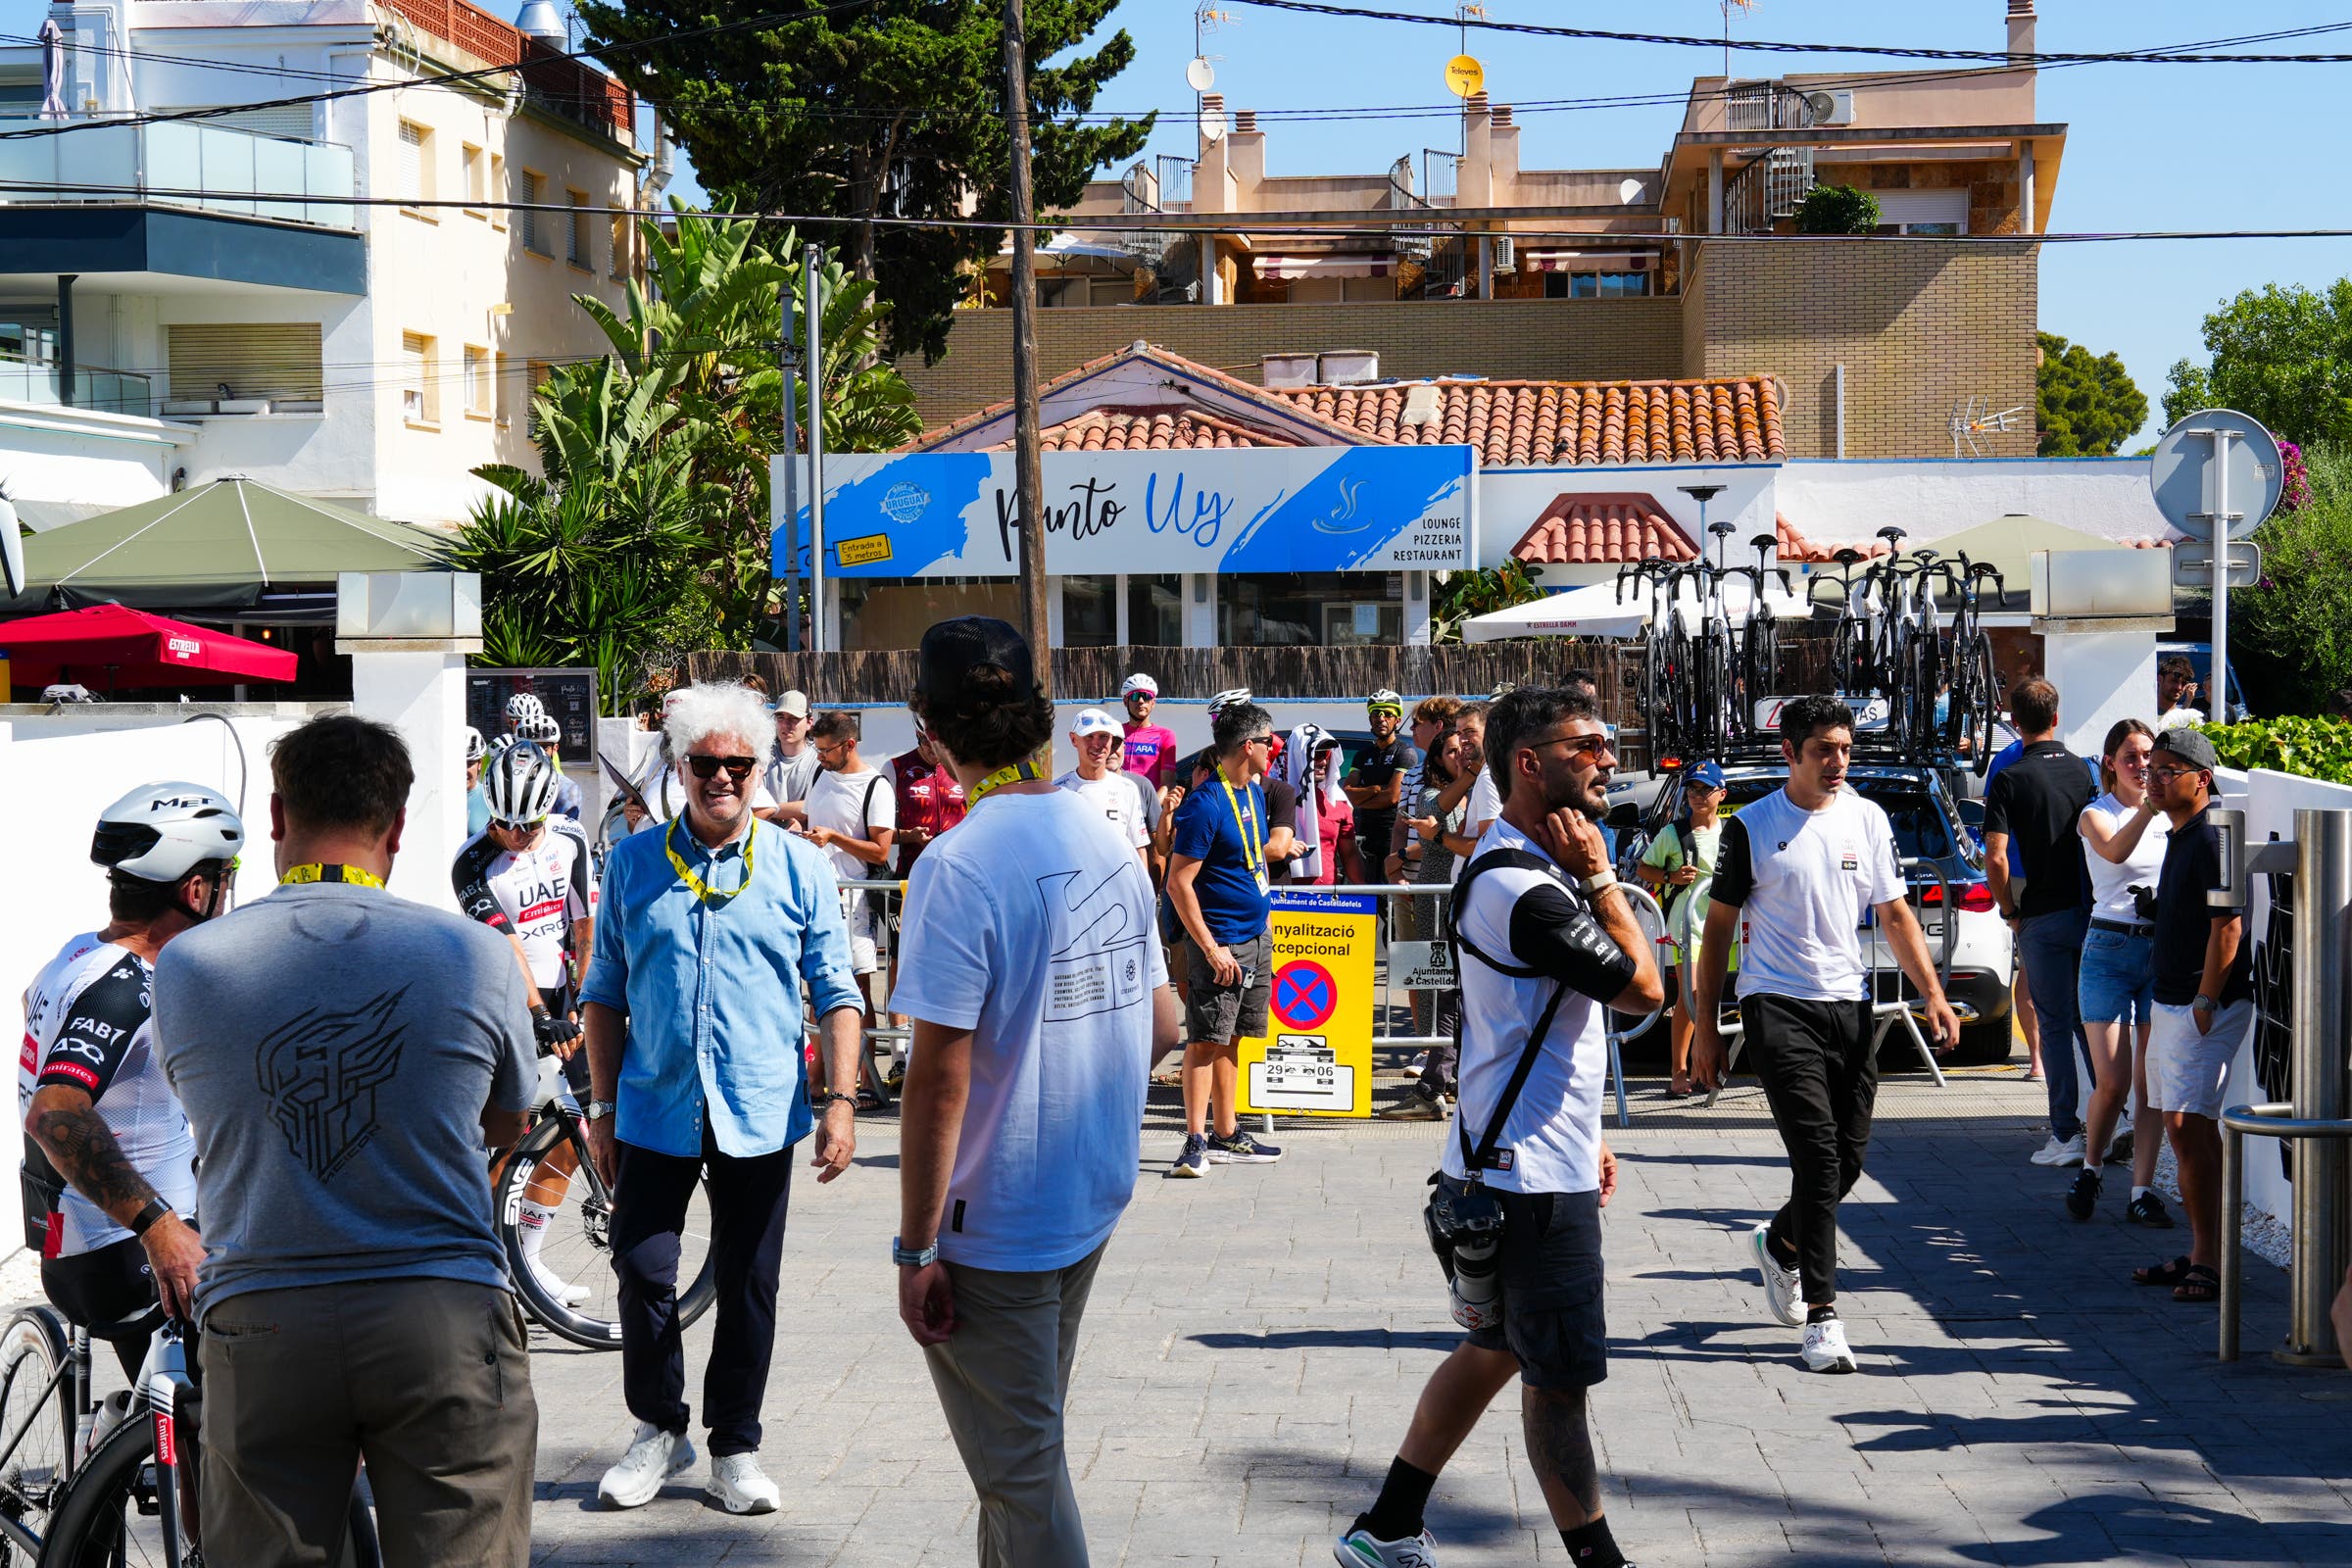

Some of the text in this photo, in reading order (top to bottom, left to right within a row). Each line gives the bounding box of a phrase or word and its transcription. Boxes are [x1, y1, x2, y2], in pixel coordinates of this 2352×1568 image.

[1450, 66, 1479, 75] Televes
[885, 493, 926, 510] URUGUAY
[1146, 472, 1235, 548] Uy
[1423, 517, 1461, 529] LOUNGE
[1414, 534, 1462, 545] PIZZERIA
[842, 542, 875, 554] Entrada
[856, 551, 882, 560] metros
[1394, 550, 1462, 561] RESTAURANT
[169, 638, 201, 654] ESTRELLA
[151, 797, 215, 811] MET
[519, 877, 565, 908] UAE
[1318, 900, 1362, 908] Castelldefels
[524, 904, 562, 919] Emirates
[521, 918, 567, 941] XRG
[1274, 923, 1354, 938] nyalització
[1272, 942, 1350, 957] xcepcional
[1412, 967, 1455, 976] Ajuntame
[1267, 1064, 1334, 1077] 29 06
[157, 1417, 169, 1461] Emirates
